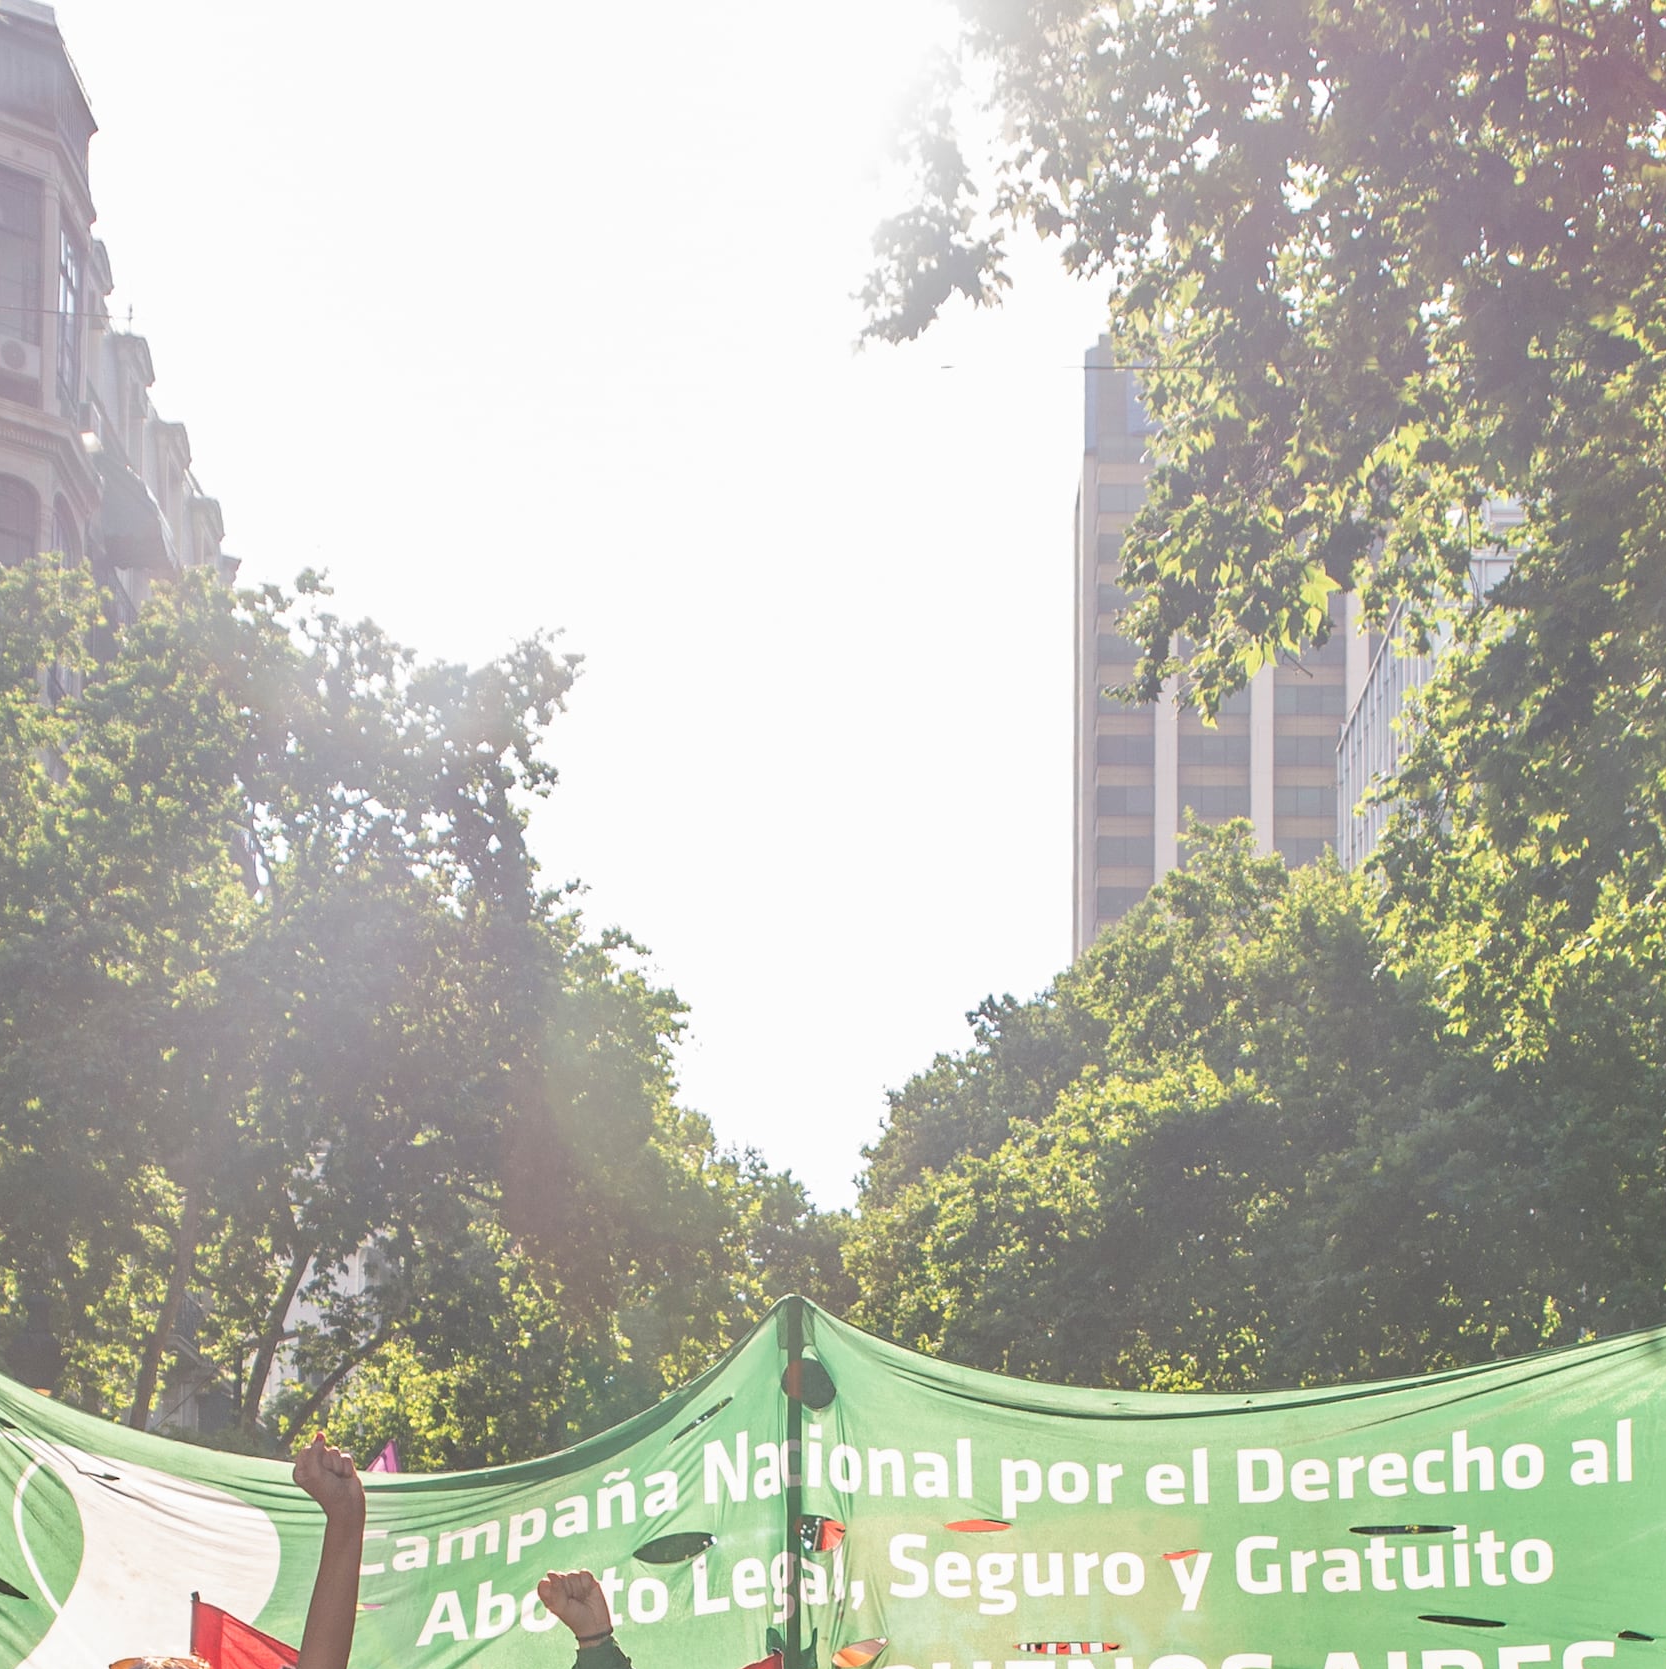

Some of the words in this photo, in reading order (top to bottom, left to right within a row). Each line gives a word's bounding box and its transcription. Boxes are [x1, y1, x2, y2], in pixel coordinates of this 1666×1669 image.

[361, 1468, 680, 1576] Campaña
[703, 1424, 973, 1504] Nacional
[1001, 1458, 1124, 1519] por
[1144, 1447, 1209, 1504] el
[1236, 1430, 1545, 1503] Derecho
[1570, 1418, 1633, 1486] al
[415, 1566, 680, 1647] Aboto
[692, 1552, 865, 1625] Legal,
[889, 1532, 1145, 1616] Seguro
[1169, 1552, 1213, 1611] y
[1235, 1524, 1554, 1595] Gratuito
